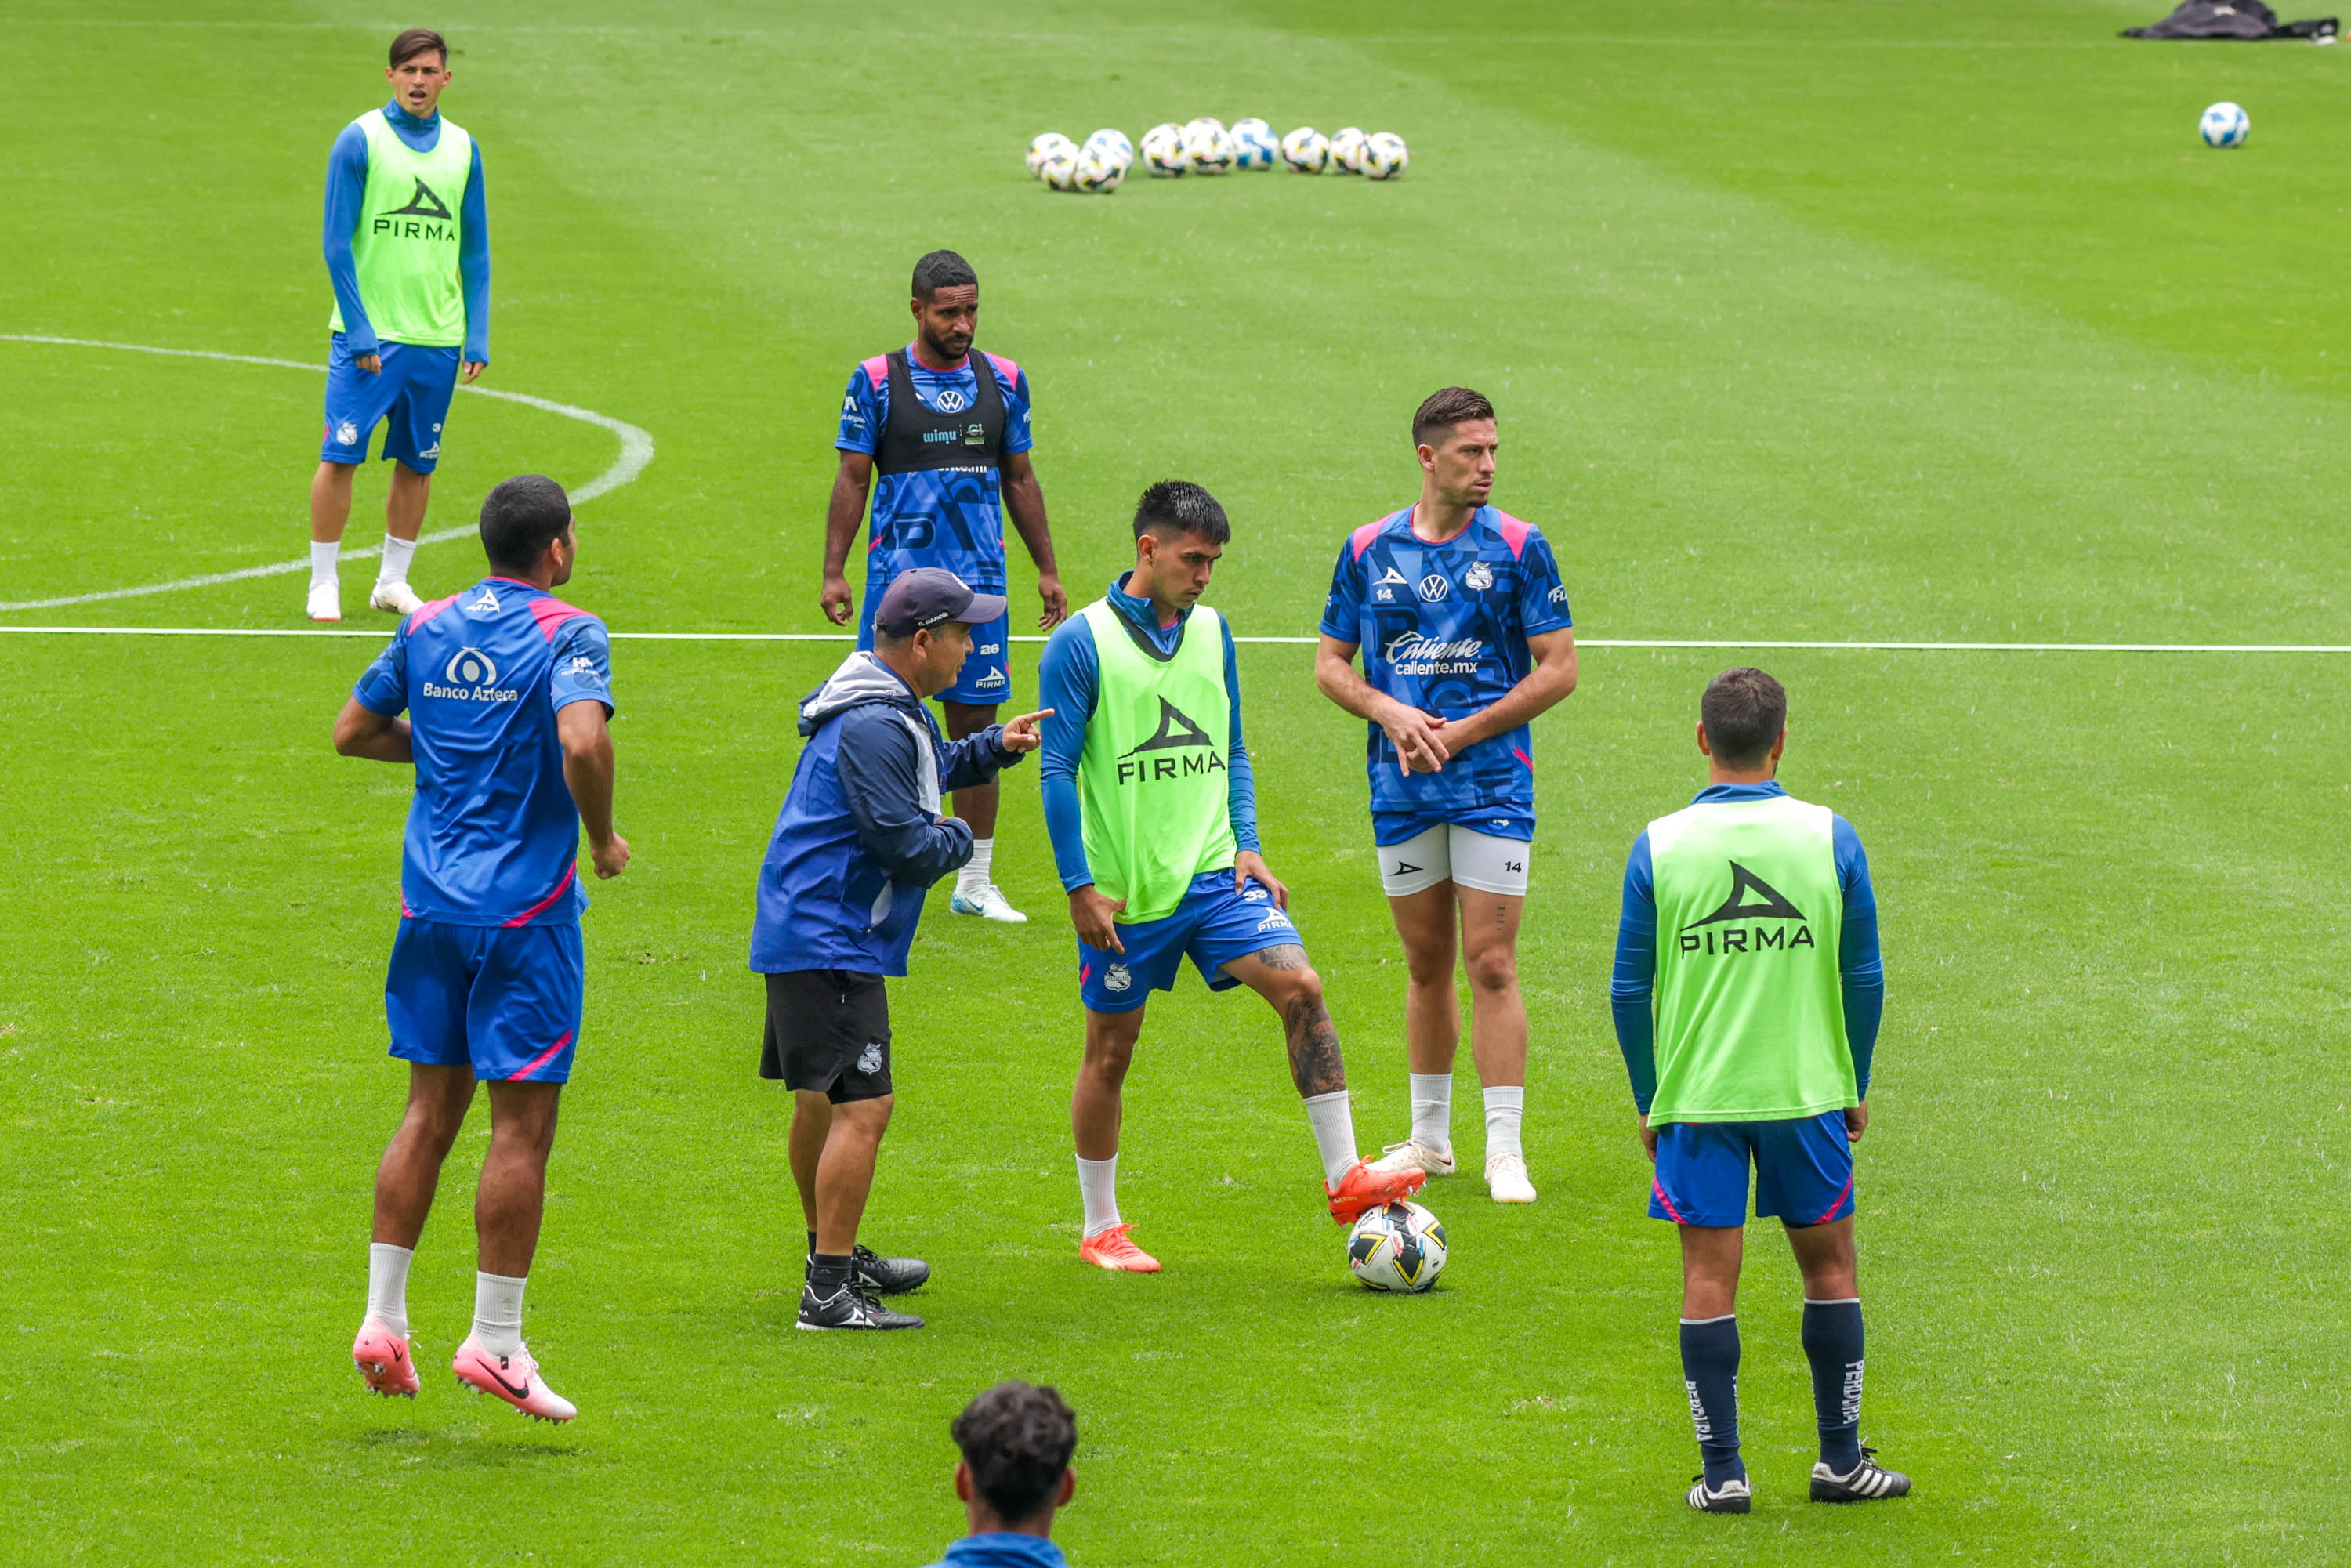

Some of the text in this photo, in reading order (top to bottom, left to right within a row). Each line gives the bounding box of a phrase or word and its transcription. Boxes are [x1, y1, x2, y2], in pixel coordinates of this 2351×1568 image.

[374, 219, 455, 241] PIRMA
[1377, 589, 1393, 601] 14
[980, 643, 1000, 655] 26
[1384, 631, 1483, 664] Caliente
[1395, 661, 1478, 675] caliente.mx
[976, 679, 1005, 689] PIRMA
[423, 682, 518, 702] Banco Azteca
[1505, 860, 1522, 873] 14
[1243, 889, 1268, 902] 33
[1680, 925, 1815, 959] PIRMA
